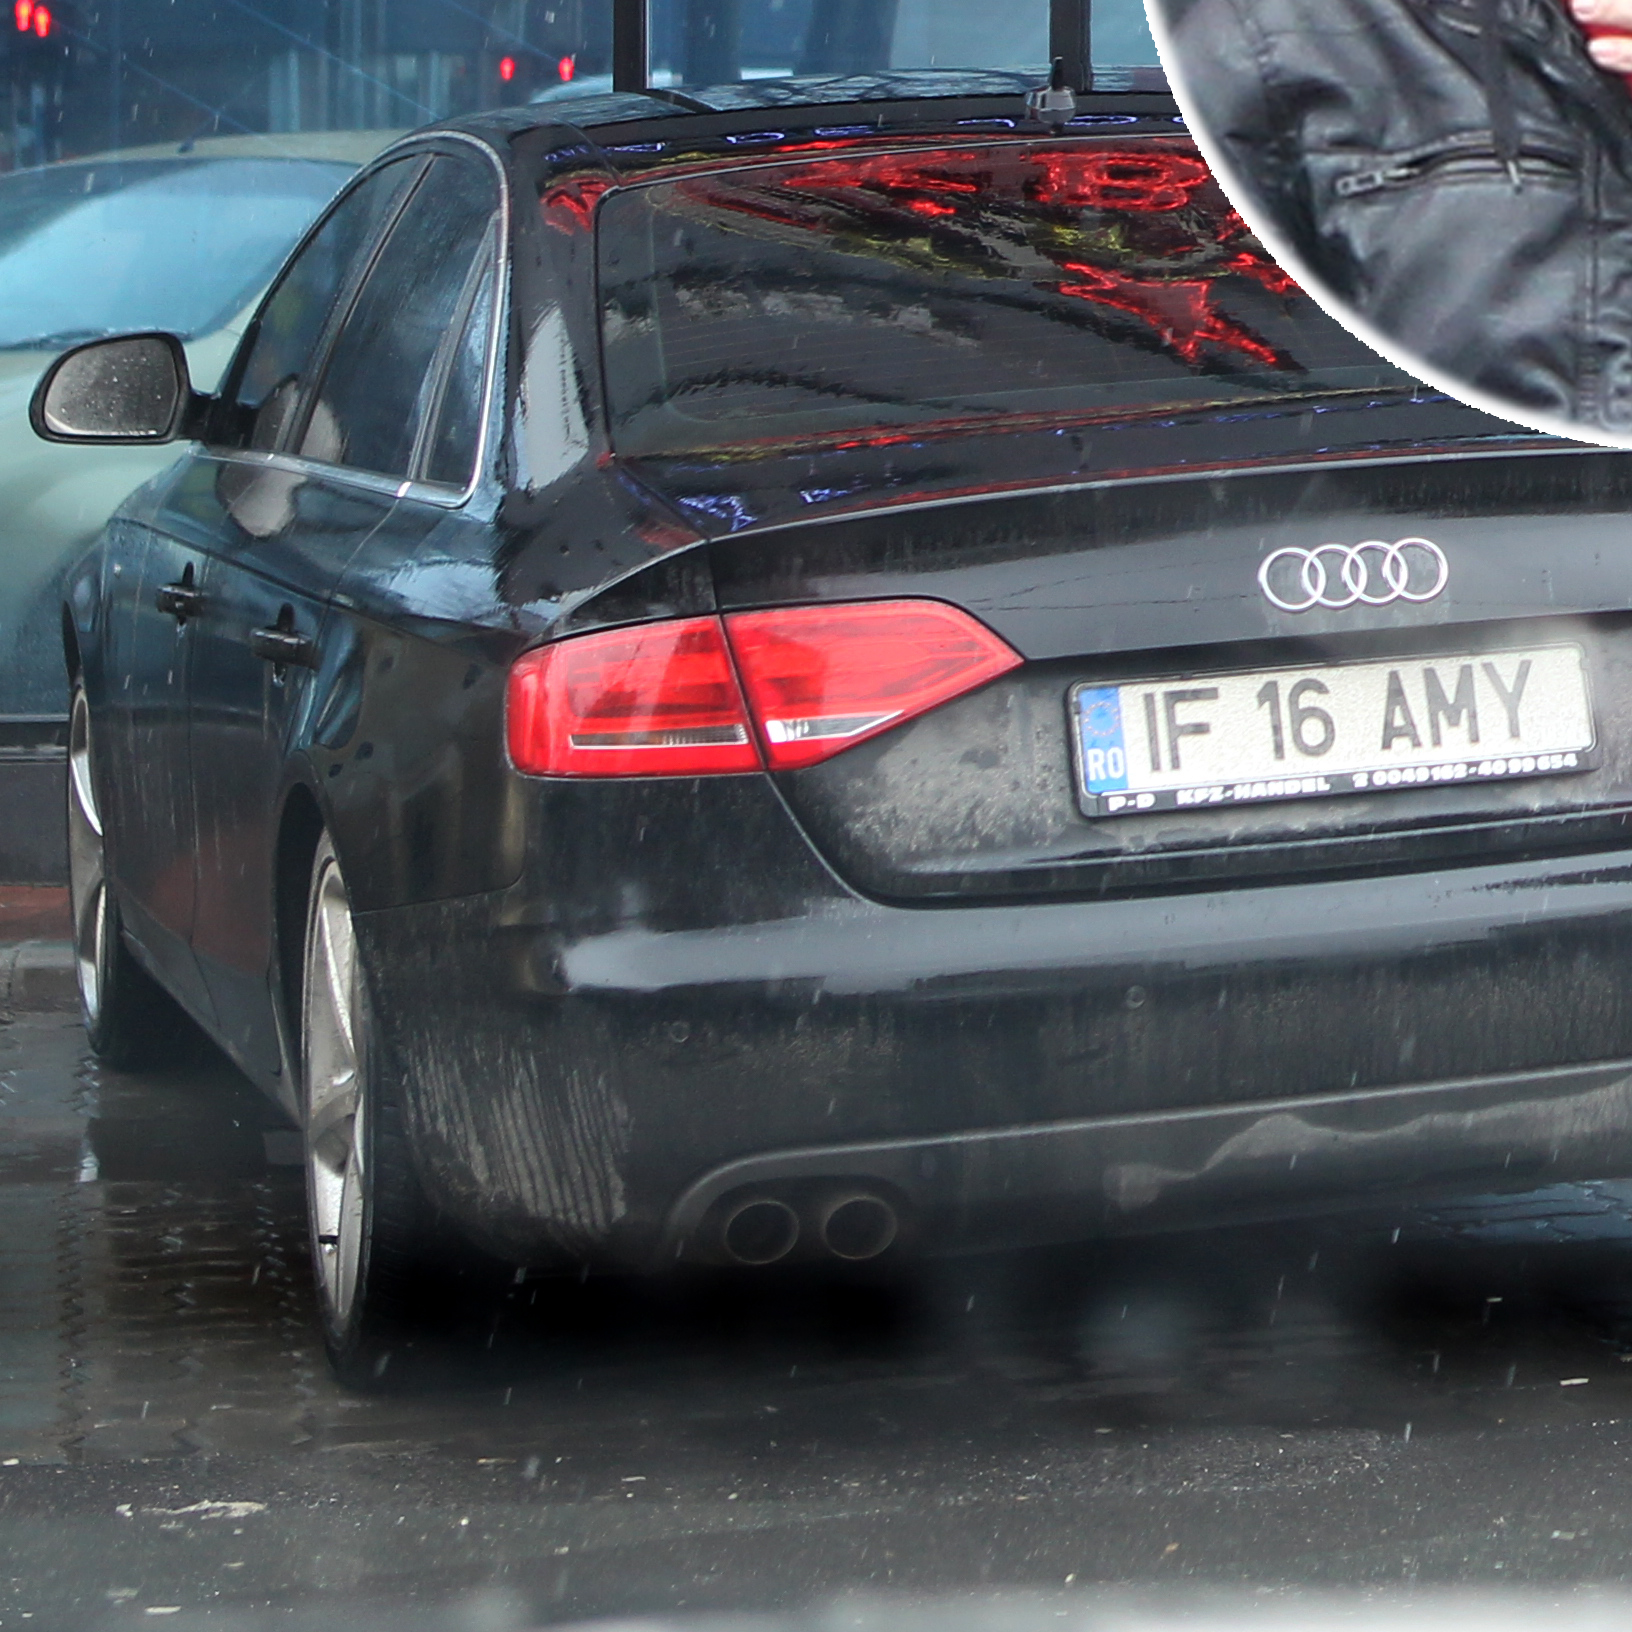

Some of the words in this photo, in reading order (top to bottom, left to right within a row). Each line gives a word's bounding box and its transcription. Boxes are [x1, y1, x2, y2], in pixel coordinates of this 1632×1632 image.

[1142, 686, 1219, 773] IF
[1255, 677, 1337, 762] 16
[1380, 658, 1534, 751] AMY
[1086, 746, 1125, 782] RO
[1175, 776, 1332, 806] KFZ-HANDEL
